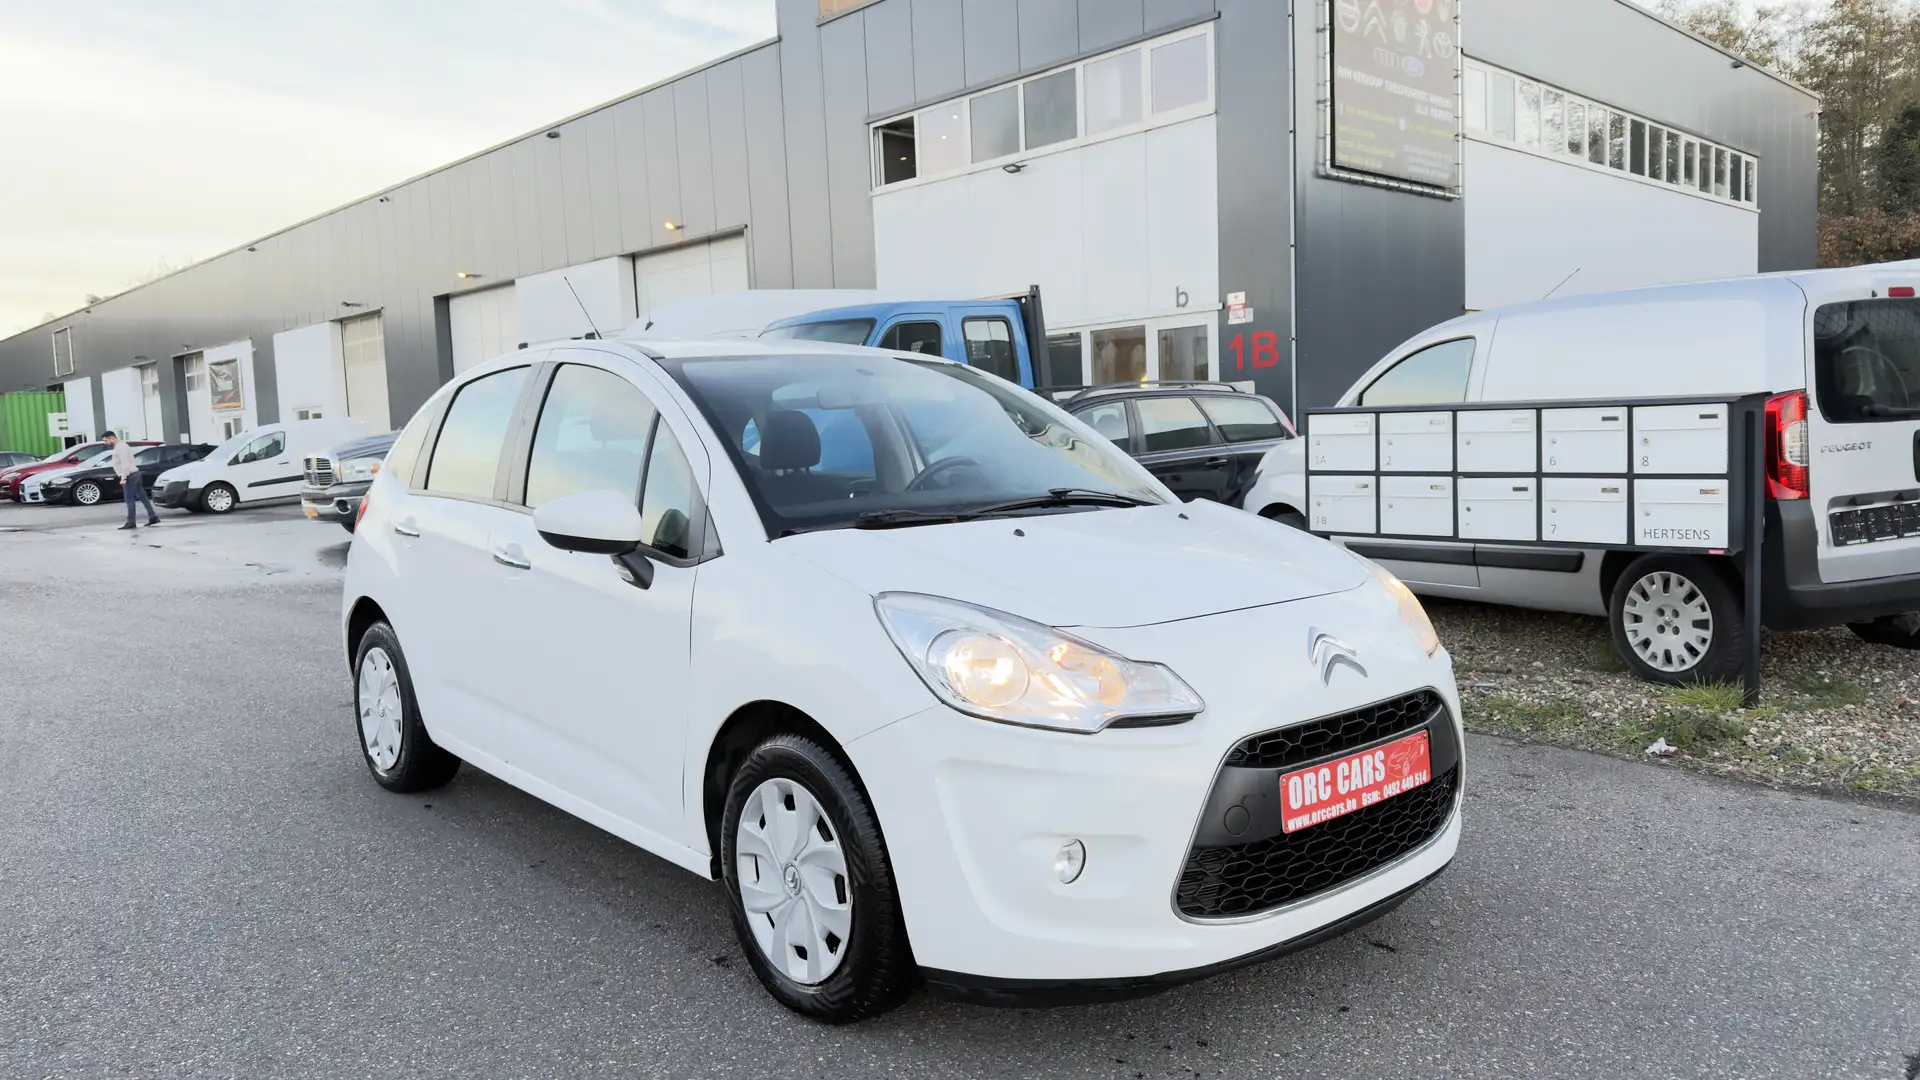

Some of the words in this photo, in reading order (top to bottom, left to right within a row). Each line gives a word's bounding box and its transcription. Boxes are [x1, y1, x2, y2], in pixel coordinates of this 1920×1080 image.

[1176, 286, 1189, 308] b
[1229, 330, 1279, 372] 1B
[1821, 441, 1873, 454] PEUGEOT
[1315, 456, 1326, 465] 1A
[1386, 456, 1393, 465] 2
[1549, 456, 1557, 466] 6
[1642, 455, 1649, 467] 8
[1550, 524, 1557, 534] 7
[1643, 528, 1710, 541] HERTSENS
[1288, 768, 1331, 810] ORC
[1337, 750, 1385, 795] CARS
[1287, 798, 1357, 831] www.orccars.be
[1362, 791, 1381, 806] Gsm:
[1384, 779, 1400, 798] 0492
[1402, 774, 1414, 791] 440
[1415, 770, 1427, 784] 514
